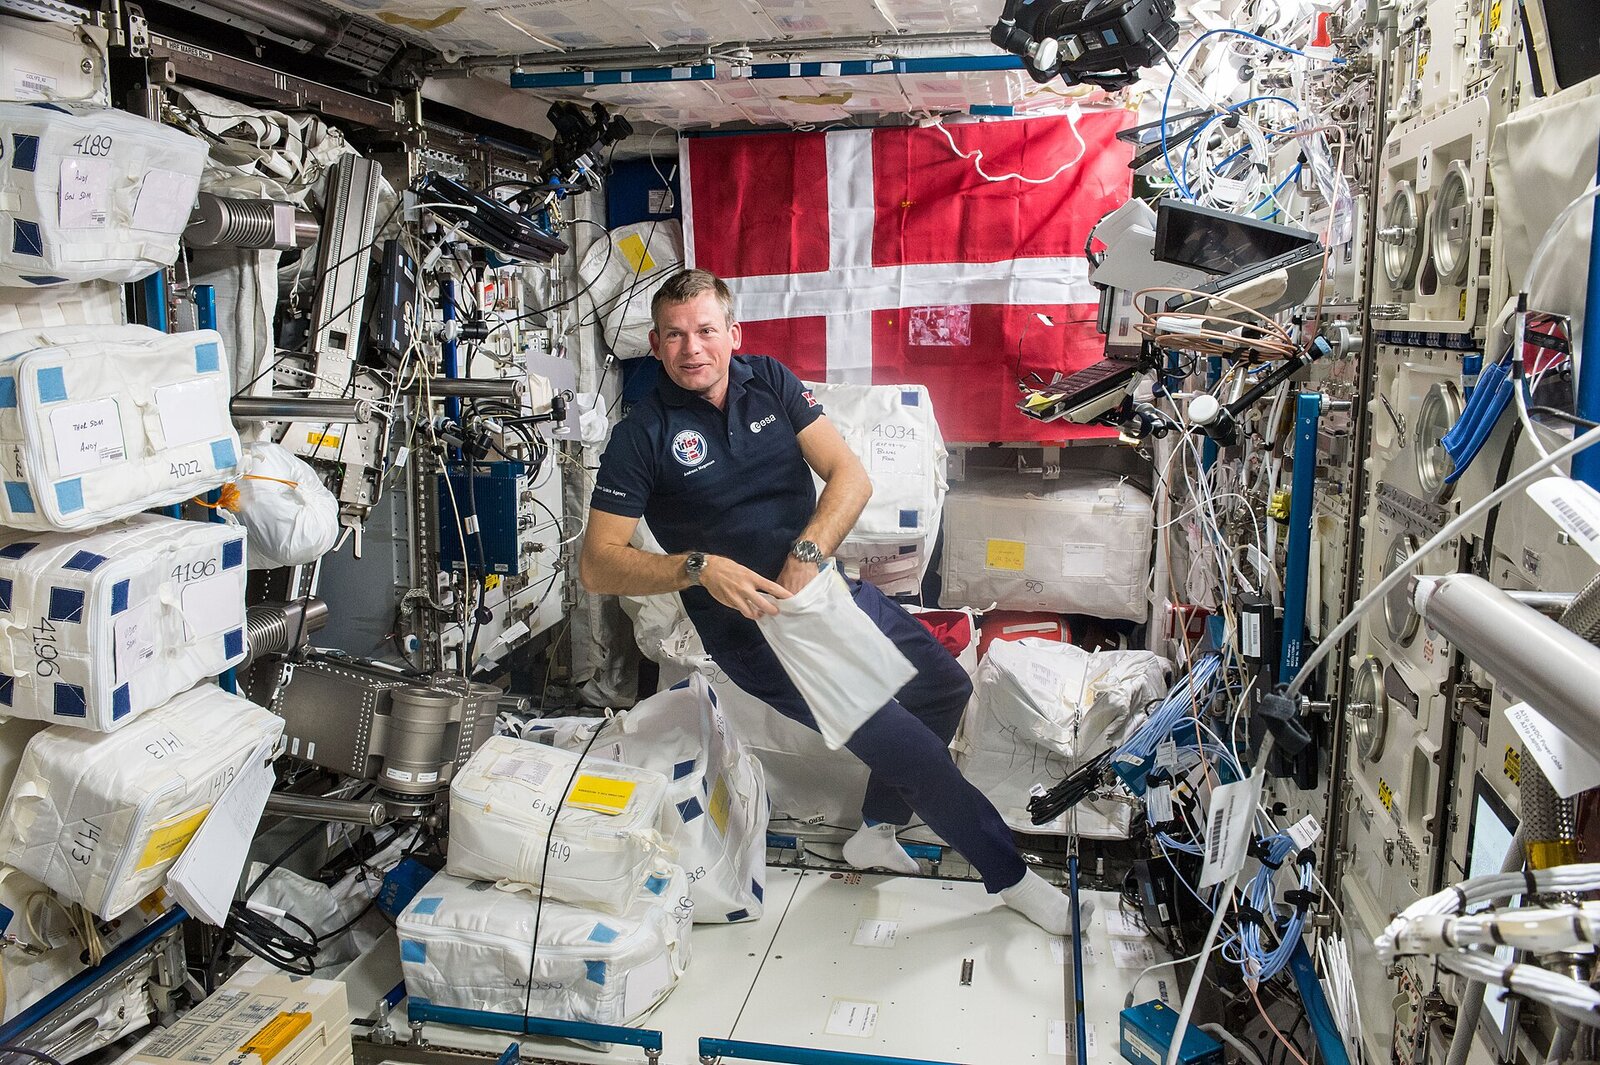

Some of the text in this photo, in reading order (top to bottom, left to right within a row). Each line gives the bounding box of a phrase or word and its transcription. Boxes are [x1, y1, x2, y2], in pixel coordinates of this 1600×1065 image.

[169, 41, 210, 59] HRF MARES Rack
[73, 134, 112, 156] 4189
[755, 414, 776, 430] esa
[872, 424, 919, 440] 4034
[677, 437, 697, 451] iriss
[169, 459, 202, 478] 4022
[613, 489, 627, 498] Agency
[859, 554, 896, 564] 4034
[171, 558, 216, 583] 4196
[33, 616, 61, 677] 4196
[145, 731, 184, 760] 1413
[1528, 733, 1543, 753] Laptop
[1540, 739, 1553, 757] Power
[1550, 755, 1563, 771] Cable
[208, 766, 235, 798] 1413
[808, 815, 825, 825] ZERO
[71, 817, 103, 866] 1413
